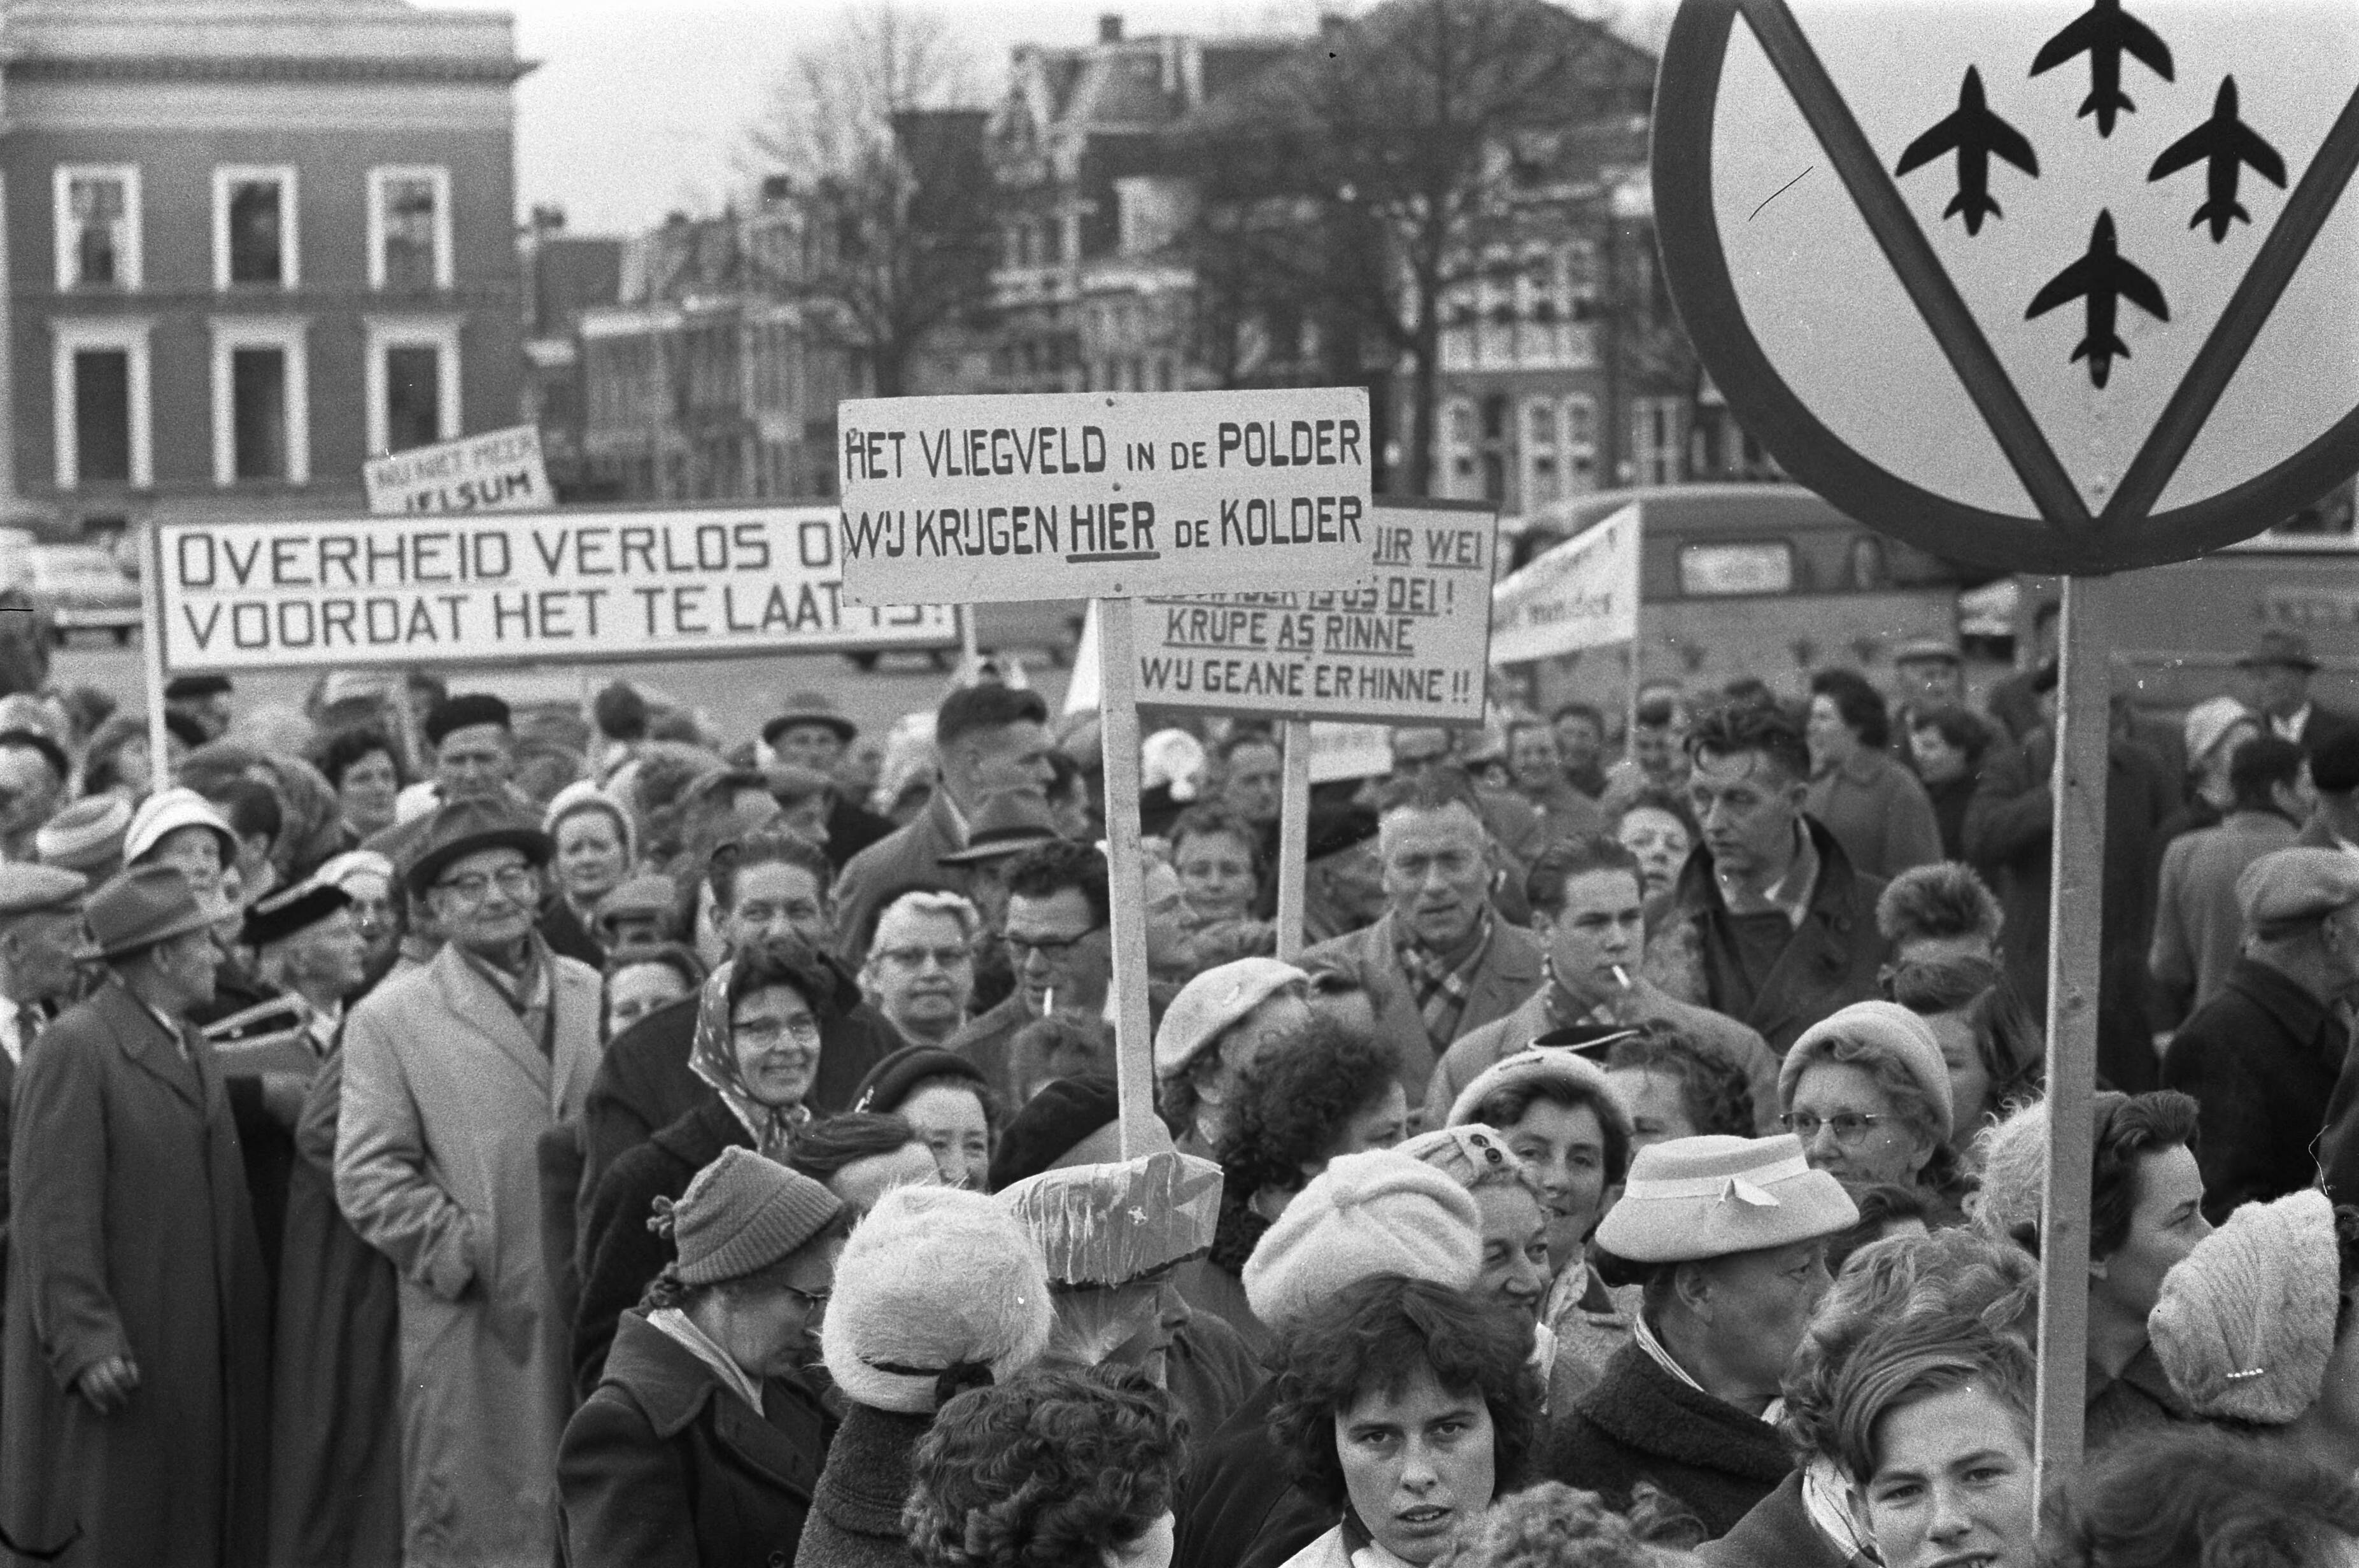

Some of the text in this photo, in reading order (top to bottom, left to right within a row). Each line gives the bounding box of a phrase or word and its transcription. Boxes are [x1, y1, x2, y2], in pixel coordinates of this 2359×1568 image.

[846, 419, 1362, 479] HET VLIEGVELD IN DE POLDER
[178, 520, 832, 586] OVERHEID VERLOS O
[916, 505, 1058, 557] KRIJGEN
[1070, 501, 1156, 553] HIER
[1175, 519, 1210, 548] DE
[1221, 496, 1362, 546] KOLDER
[1426, 529, 1482, 563] WEI
[183, 595, 469, 650] VOORDAT
[493, 588, 608, 640] HET
[634, 584, 707, 636] TE
[723, 581, 842, 633] LAAT
[1166, 607, 1413, 651] KRUPE AS RINNE
[1203, 658, 1304, 696] GEANE
[1315, 665, 1354, 698] ER
